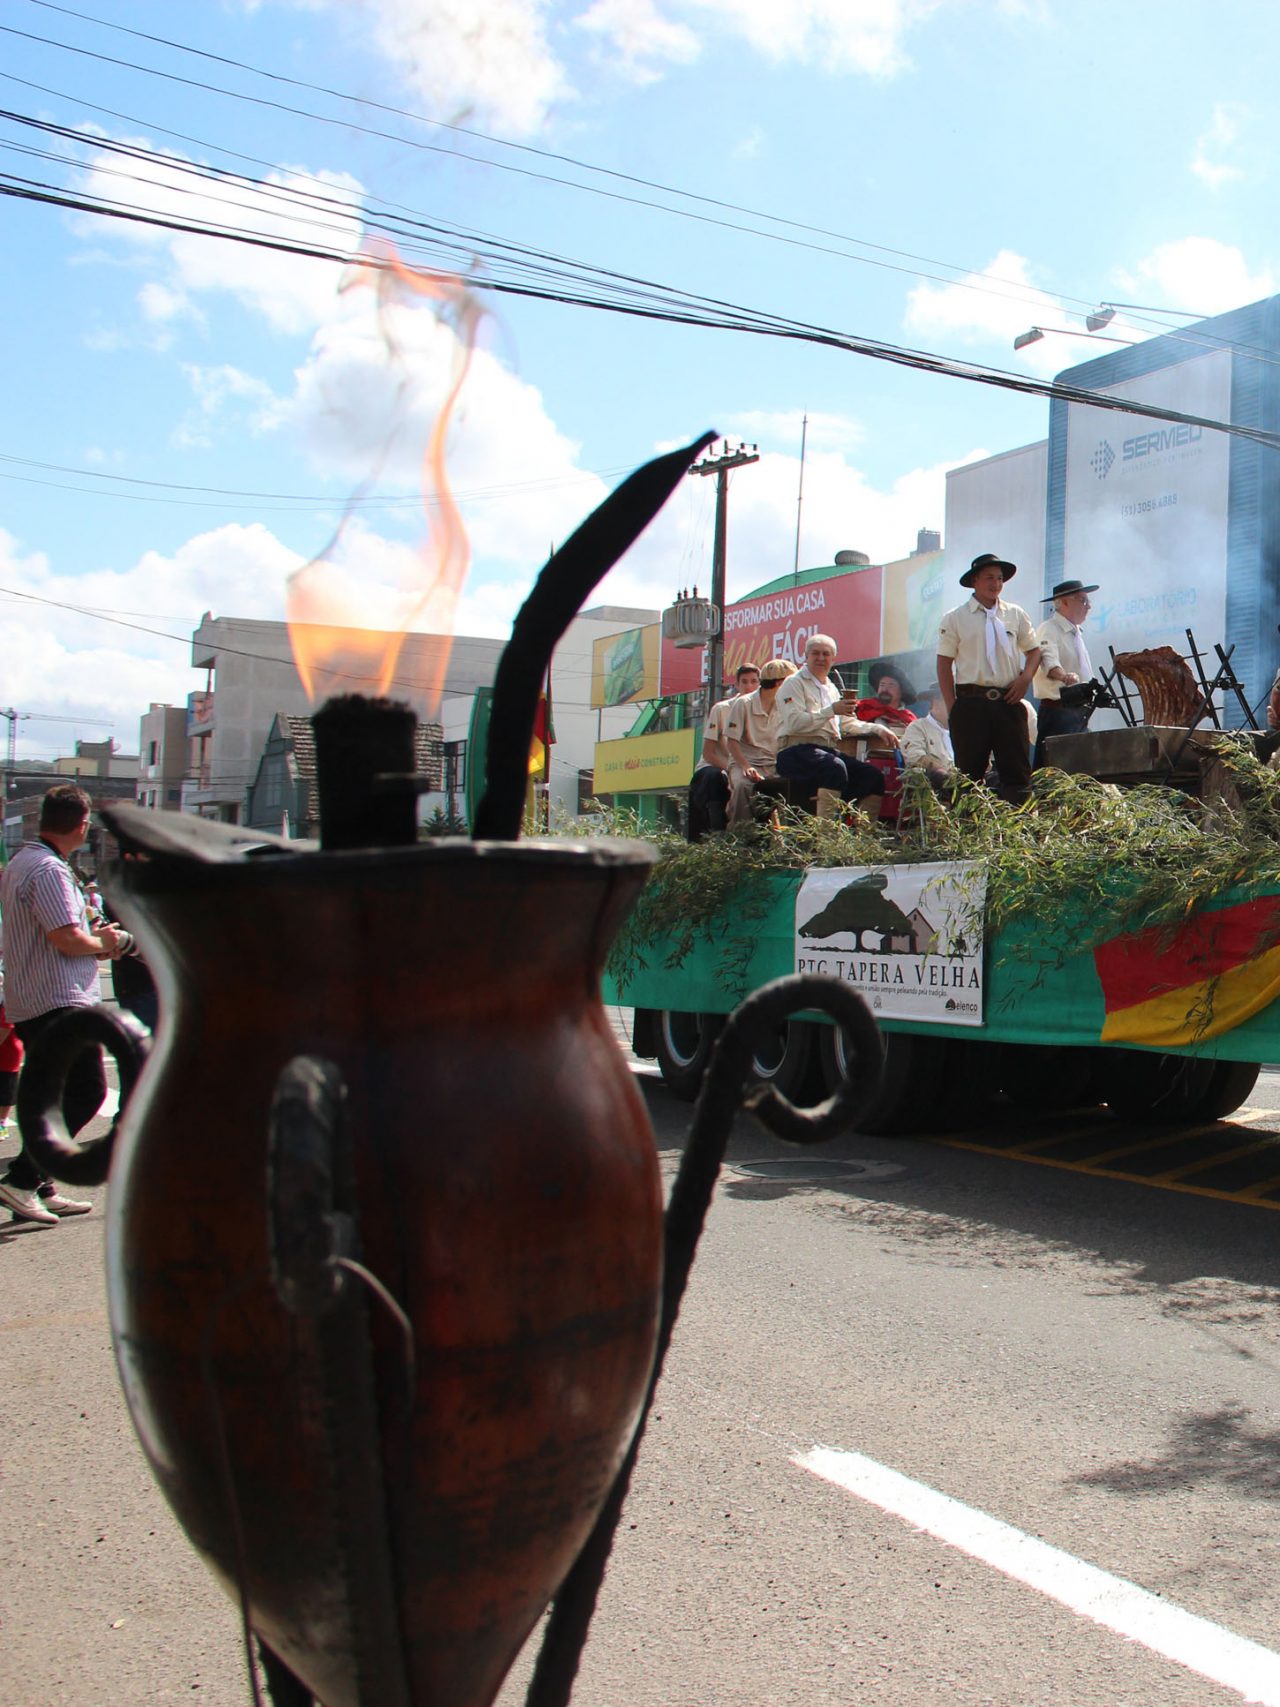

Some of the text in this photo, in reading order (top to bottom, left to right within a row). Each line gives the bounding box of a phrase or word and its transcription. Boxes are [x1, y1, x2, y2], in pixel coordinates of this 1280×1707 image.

[1122, 424, 1203, 461] SERMED
[774, 598, 795, 620] SUA
[796, 589, 826, 613] CASA
[836, 961, 905, 985] TAPERA
[915, 964, 980, 989] VELHA
